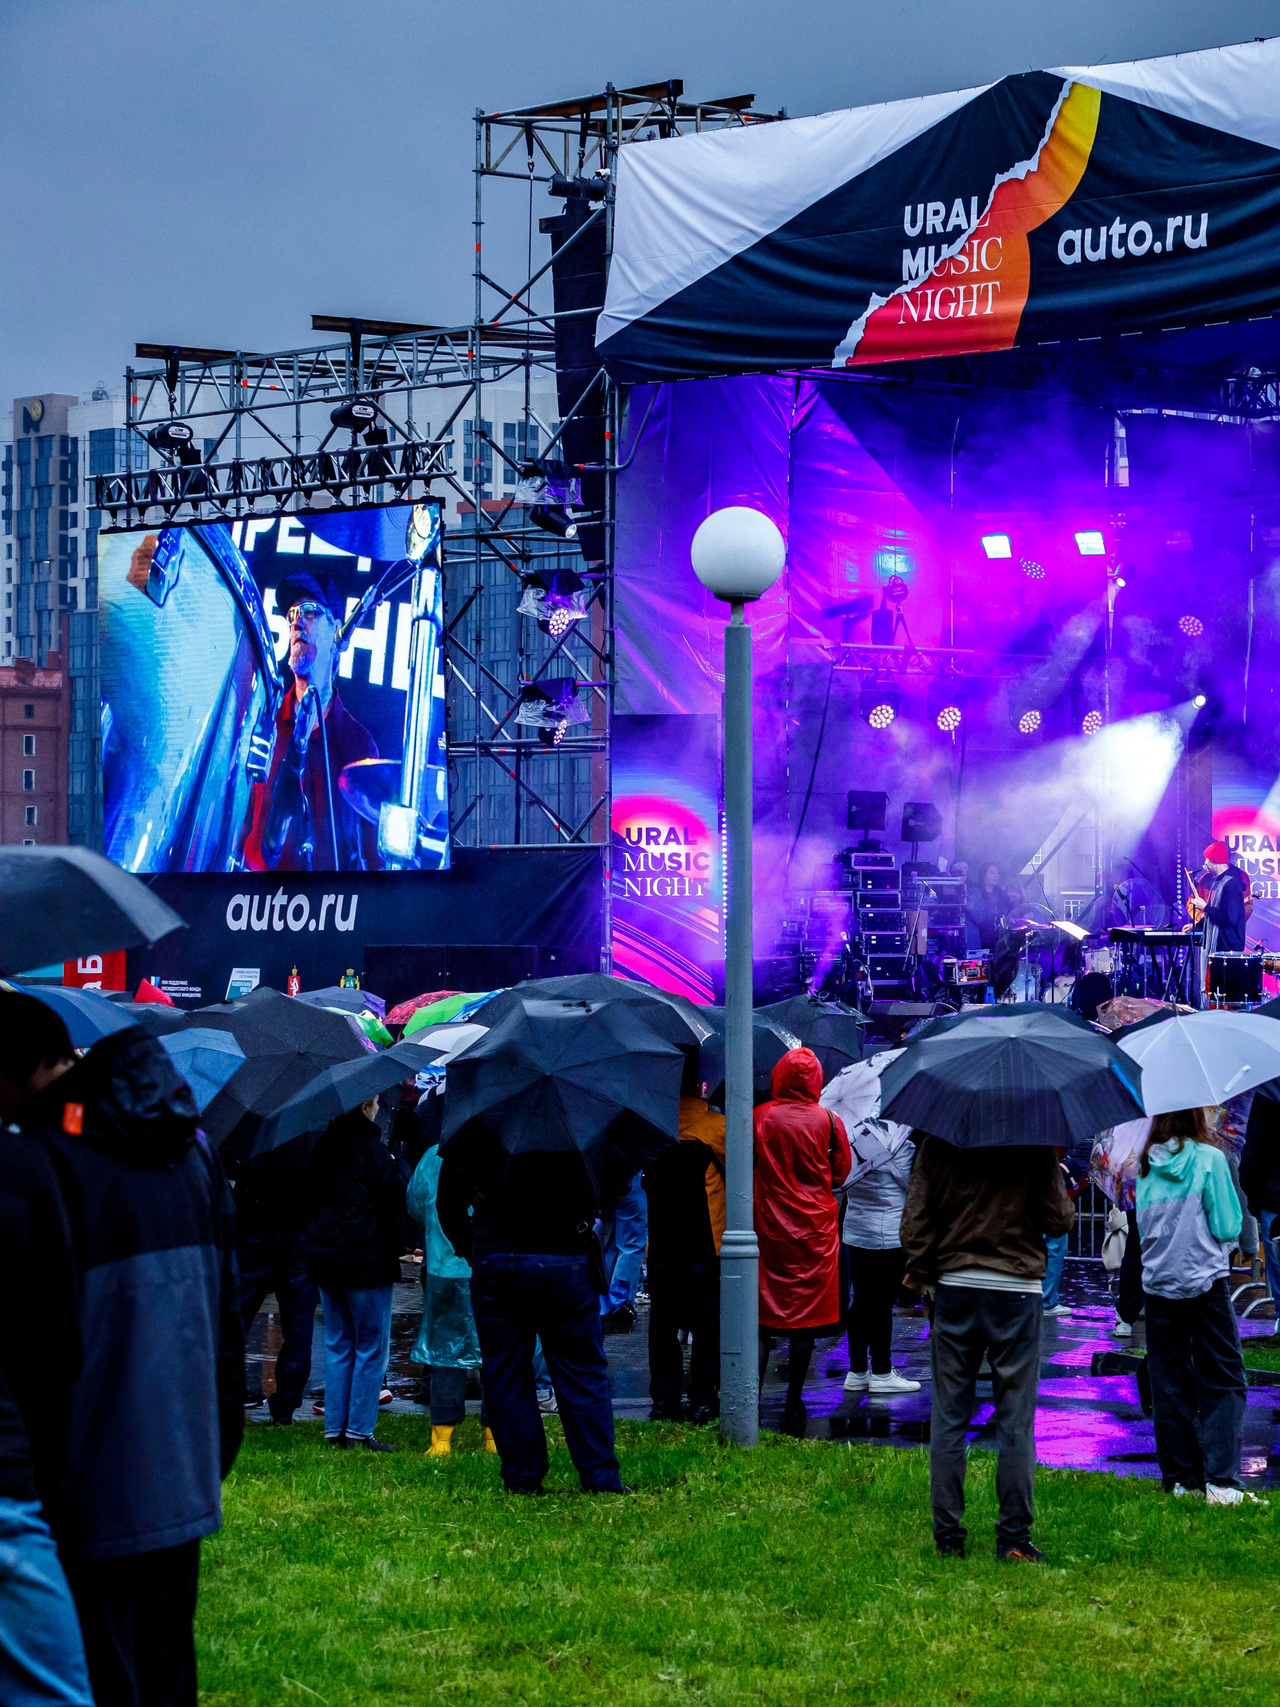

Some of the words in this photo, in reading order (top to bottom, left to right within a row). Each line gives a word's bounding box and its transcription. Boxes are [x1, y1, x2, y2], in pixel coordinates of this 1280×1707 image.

[903, 195, 991, 237] URAL
[902, 236, 1003, 281] MUSIC
[1057, 212, 1209, 265] auto.ru
[898, 281, 1001, 324] NIGHT
[625, 826, 698, 847] URAL
[623, 852, 711, 873] MUSIC
[623, 876, 711, 898] NIGHT
[225, 885, 359, 932] auto.ru
